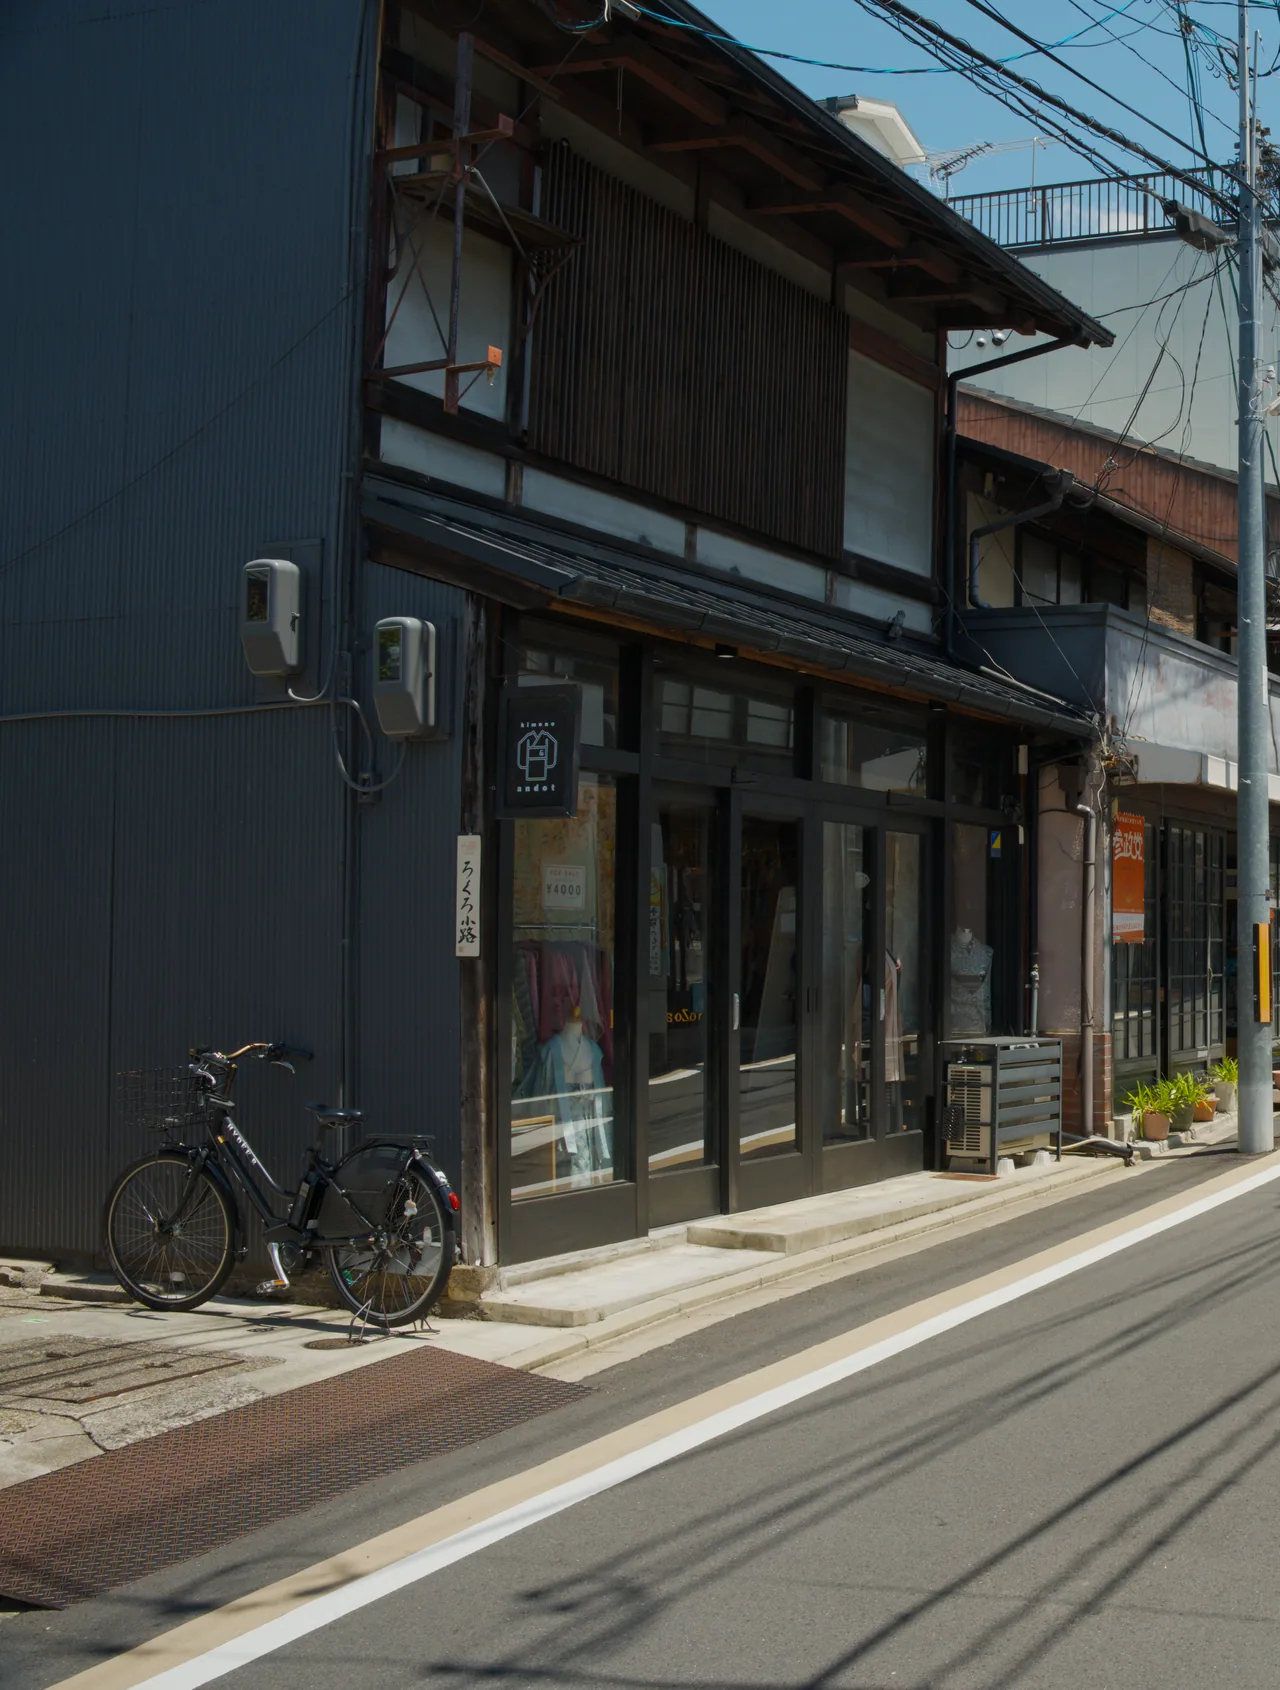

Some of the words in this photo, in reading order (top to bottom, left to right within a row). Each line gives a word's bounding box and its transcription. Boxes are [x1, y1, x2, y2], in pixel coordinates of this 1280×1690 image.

[516, 784, 556, 793] andot
[1113, 829, 1142, 861] 参政党
[546, 883, 581, 896] ¥4000
[458, 860, 477, 944] ろくろ小路
